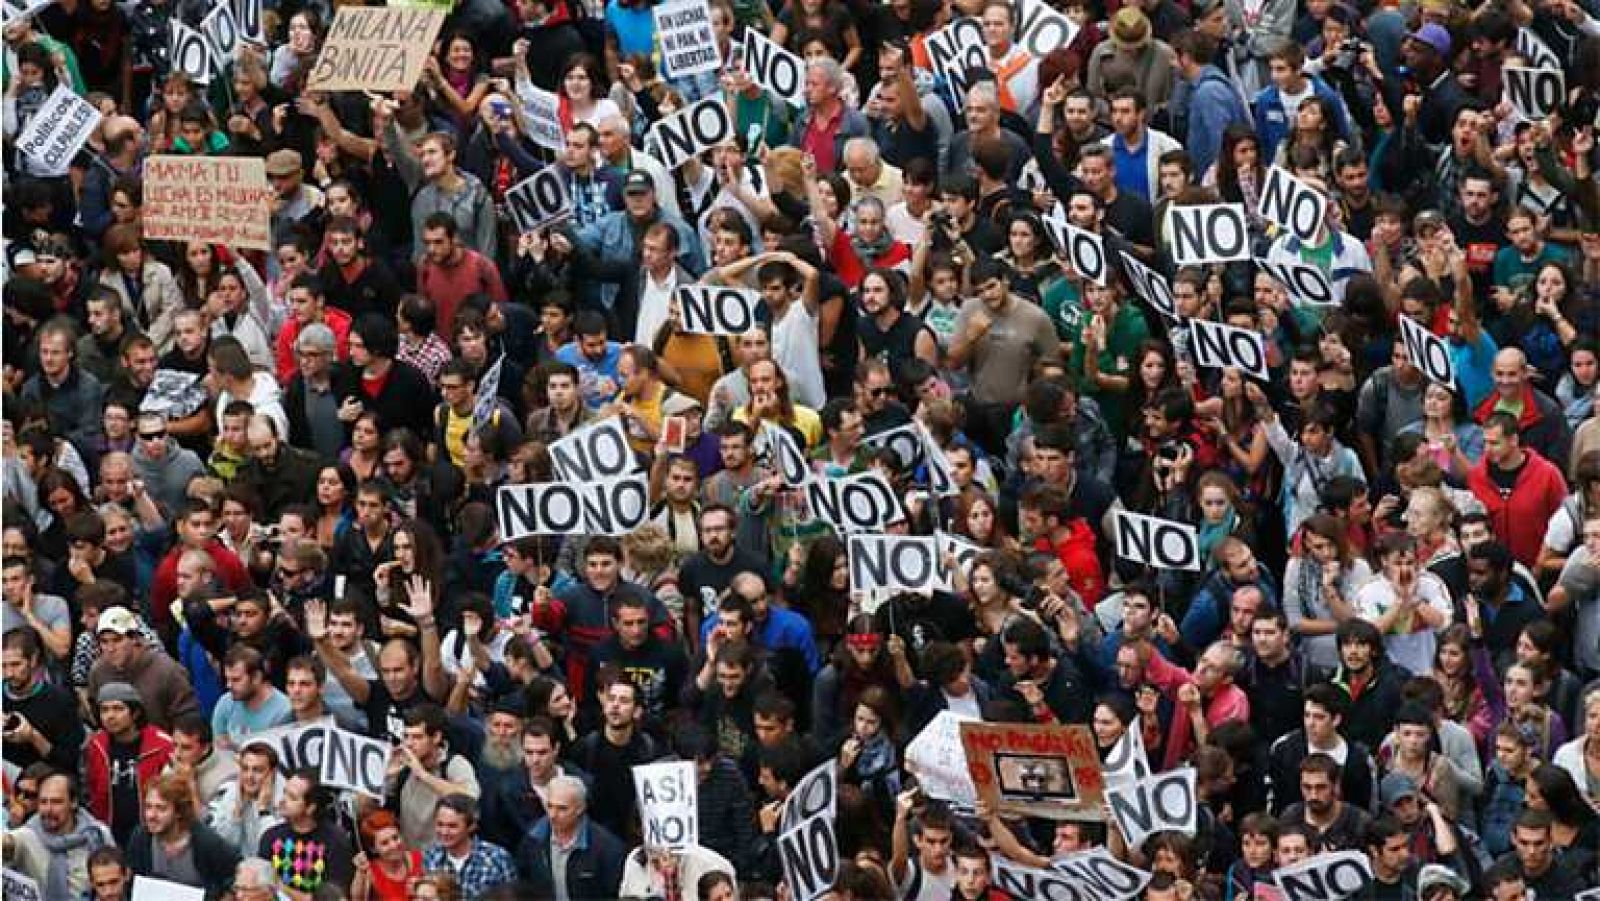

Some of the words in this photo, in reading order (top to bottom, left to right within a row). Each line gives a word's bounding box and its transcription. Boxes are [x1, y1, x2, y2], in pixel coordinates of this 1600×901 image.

[331, 10, 434, 40] MILANA
[746, 31, 798, 98] NO
[1508, 70, 1562, 117] NO
[658, 100, 728, 166] NO
[508, 172, 562, 224] NO
[1262, 169, 1321, 239] NO
[1046, 220, 1102, 280] NO
[1172, 207, 1244, 259] NO
[1121, 258, 1174, 313] NO
[1260, 261, 1331, 301] NO
[679, 287, 750, 333] NO
[1195, 322, 1262, 372] NO
[1403, 319, 1450, 381] NO
[553, 424, 626, 482] NO
[501, 485, 580, 538] NO
[583, 480, 646, 533] NO
[808, 481, 878, 527] NO
[851, 539, 932, 588] NO
[1119, 514, 1194, 566] NO
[326, 729, 384, 793] NO
[643, 769, 693, 807] ASÍ,
[1108, 777, 1192, 843] NO
[649, 815, 693, 844] NO!
[782, 817, 837, 901] NO
[1059, 857, 1140, 899] NO
[1281, 858, 1372, 901] NO
